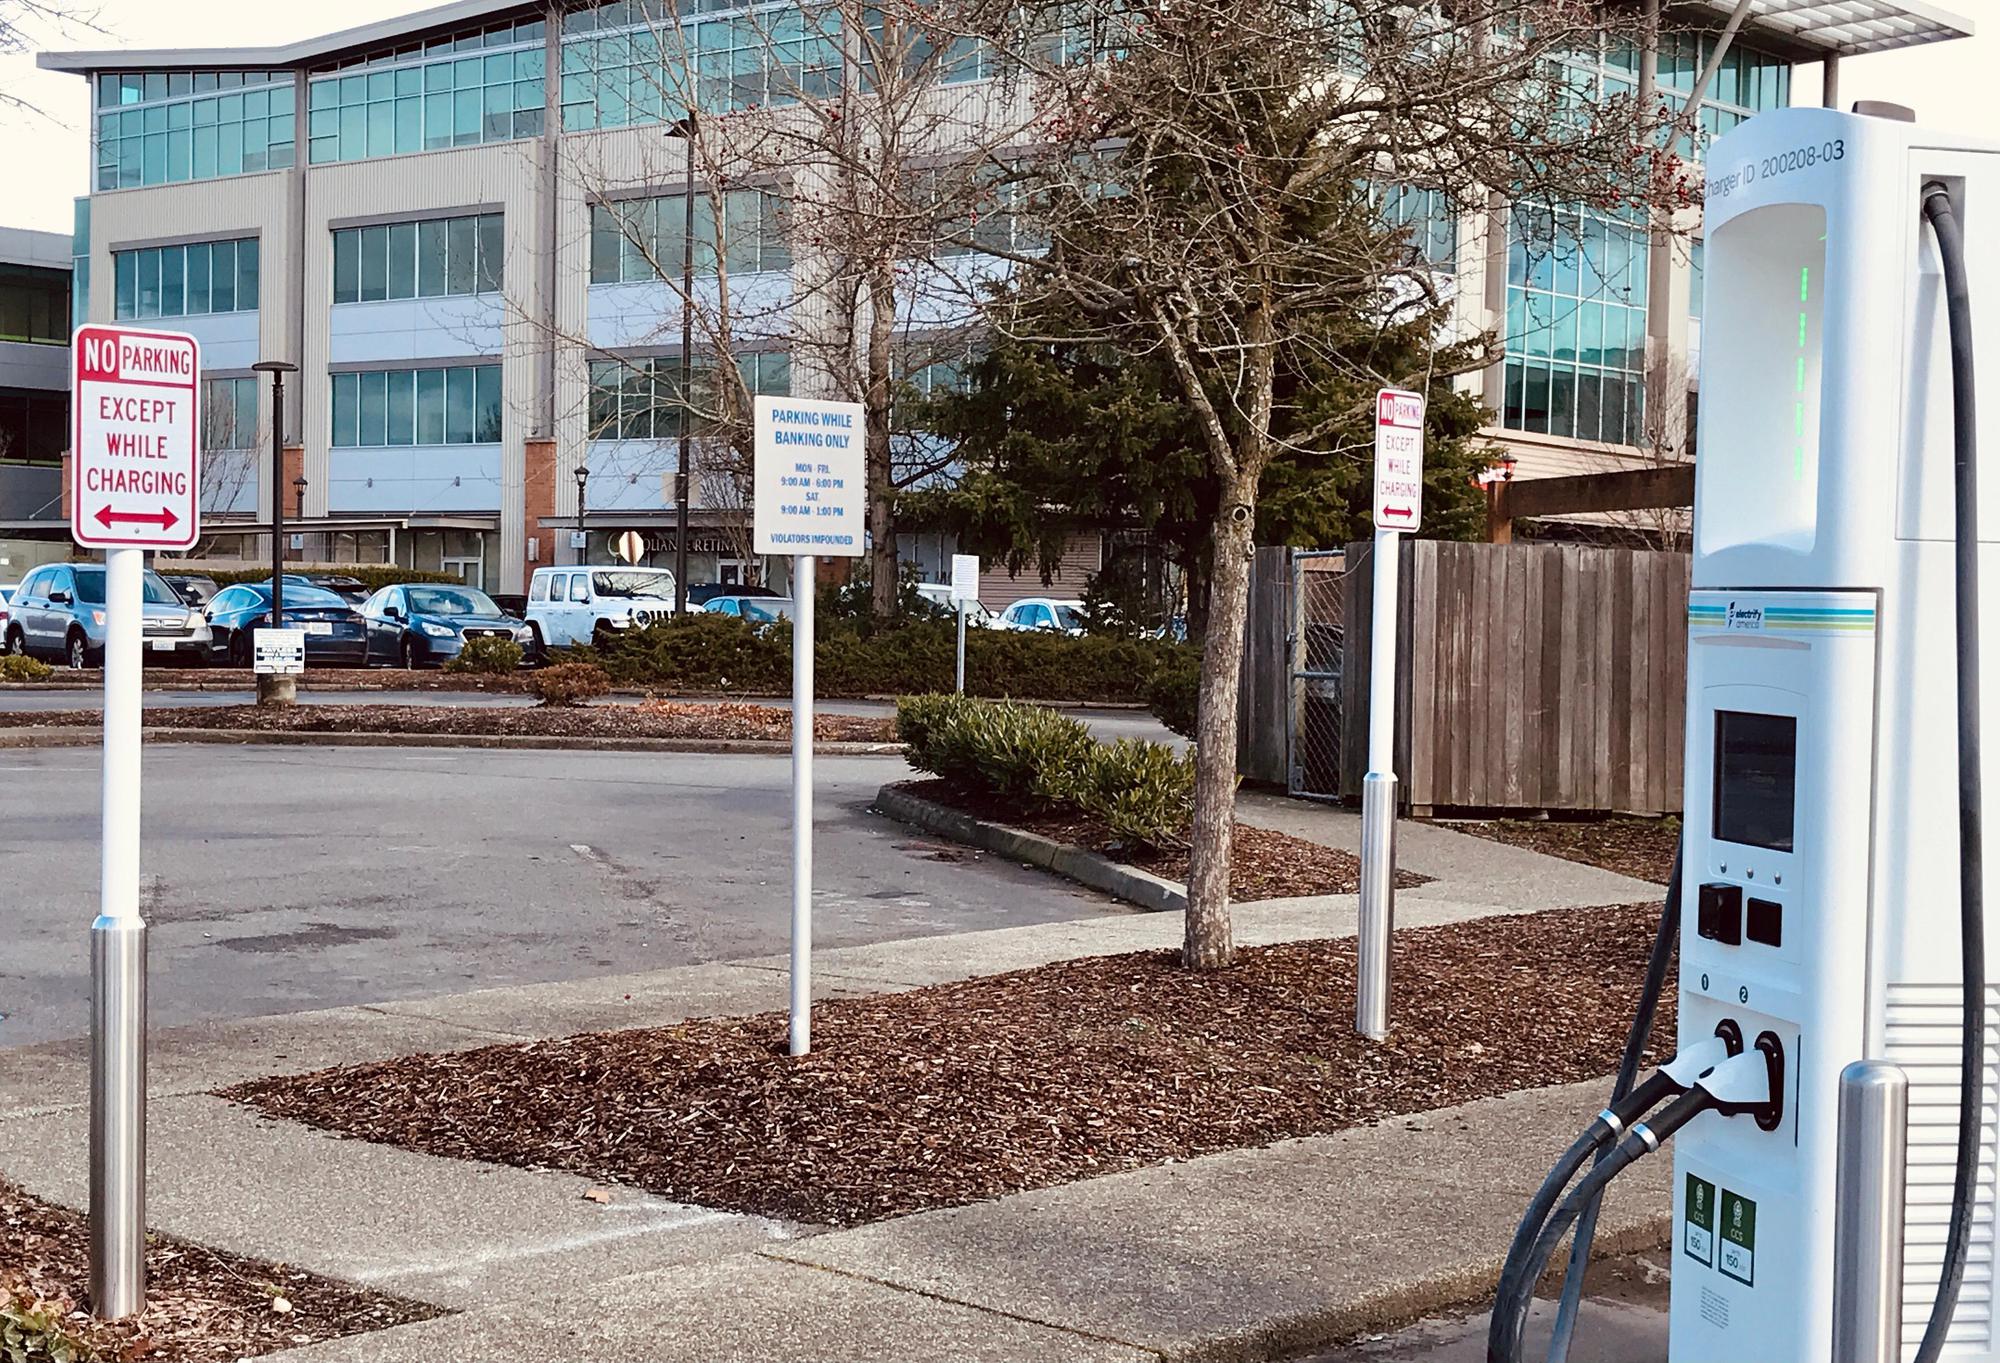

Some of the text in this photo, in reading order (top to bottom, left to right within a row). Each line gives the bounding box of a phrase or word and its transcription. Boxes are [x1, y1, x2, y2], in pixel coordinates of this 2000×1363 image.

[1743, 164, 1755, 185] ID
[1761, 139, 1845, 179] 200208-03
[84, 337, 190, 375] NO PARKING
[100, 396, 176, 424] EXCEPT
[1381, 398, 1420, 421] NO PARKING
[772, 409, 853, 428] PARKING WHILE
[106, 433, 168, 459] WHILE
[775, 431, 850, 449] BANKING ONLY
[1386, 435, 1414, 452] EXCEPT
[1387, 458, 1411, 475] WHILE
[87, 467, 186, 496] CHARGING
[780, 476, 798, 486] 9:00
[799, 478, 811, 487] AM
[832, 479, 844, 488] PM
[1380, 481, 1417, 498] CHARGING
[780, 505, 798, 514] 9:00
[799, 506, 811, 515] AM
[832, 507, 844, 516] PM
[771, 533, 854, 545] VIOLATORS IMPOUNDED
[1736, 609, 1761, 621] electrify
[1690, 1235, 1701, 1251] 150
[1731, 1229, 1743, 1242] CCS
[1726, 1253, 1739, 1269] 150
